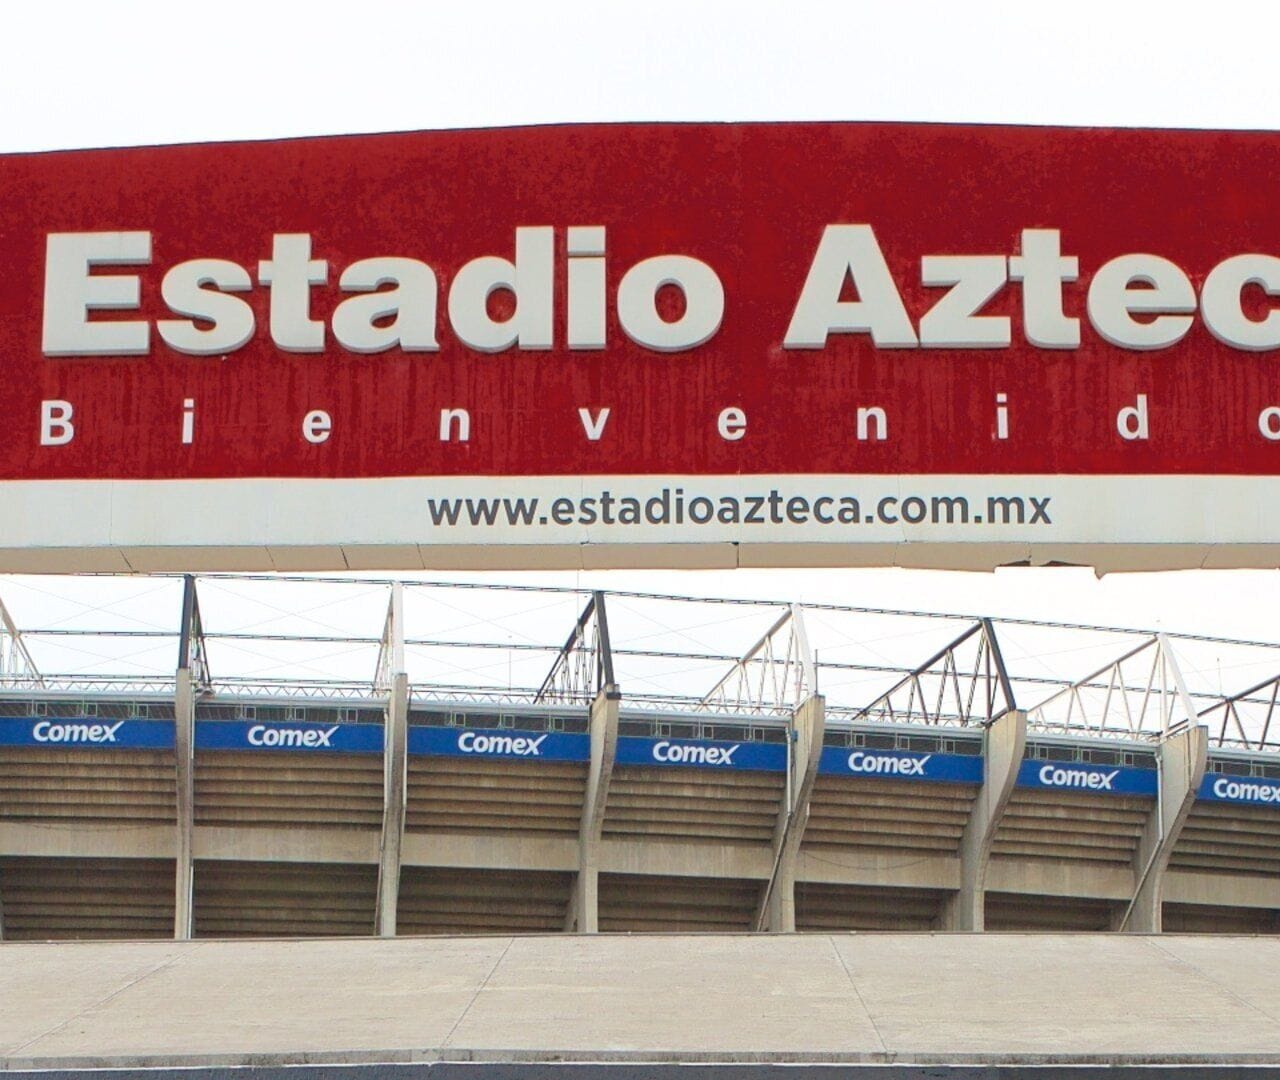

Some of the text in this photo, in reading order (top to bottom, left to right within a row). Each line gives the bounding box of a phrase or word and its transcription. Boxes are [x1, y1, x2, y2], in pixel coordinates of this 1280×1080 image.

[42, 226, 724, 356] Estadio
[427, 488, 1052, 526] www.estadioazteca.com.mx
[32, 720, 124, 743] Comex
[248, 724, 339, 747] Comex
[458, 732, 547, 755] Comex
[653, 741, 739, 765] Comex
[848, 752, 931, 775] Comex
[1039, 765, 1119, 790] Comex
